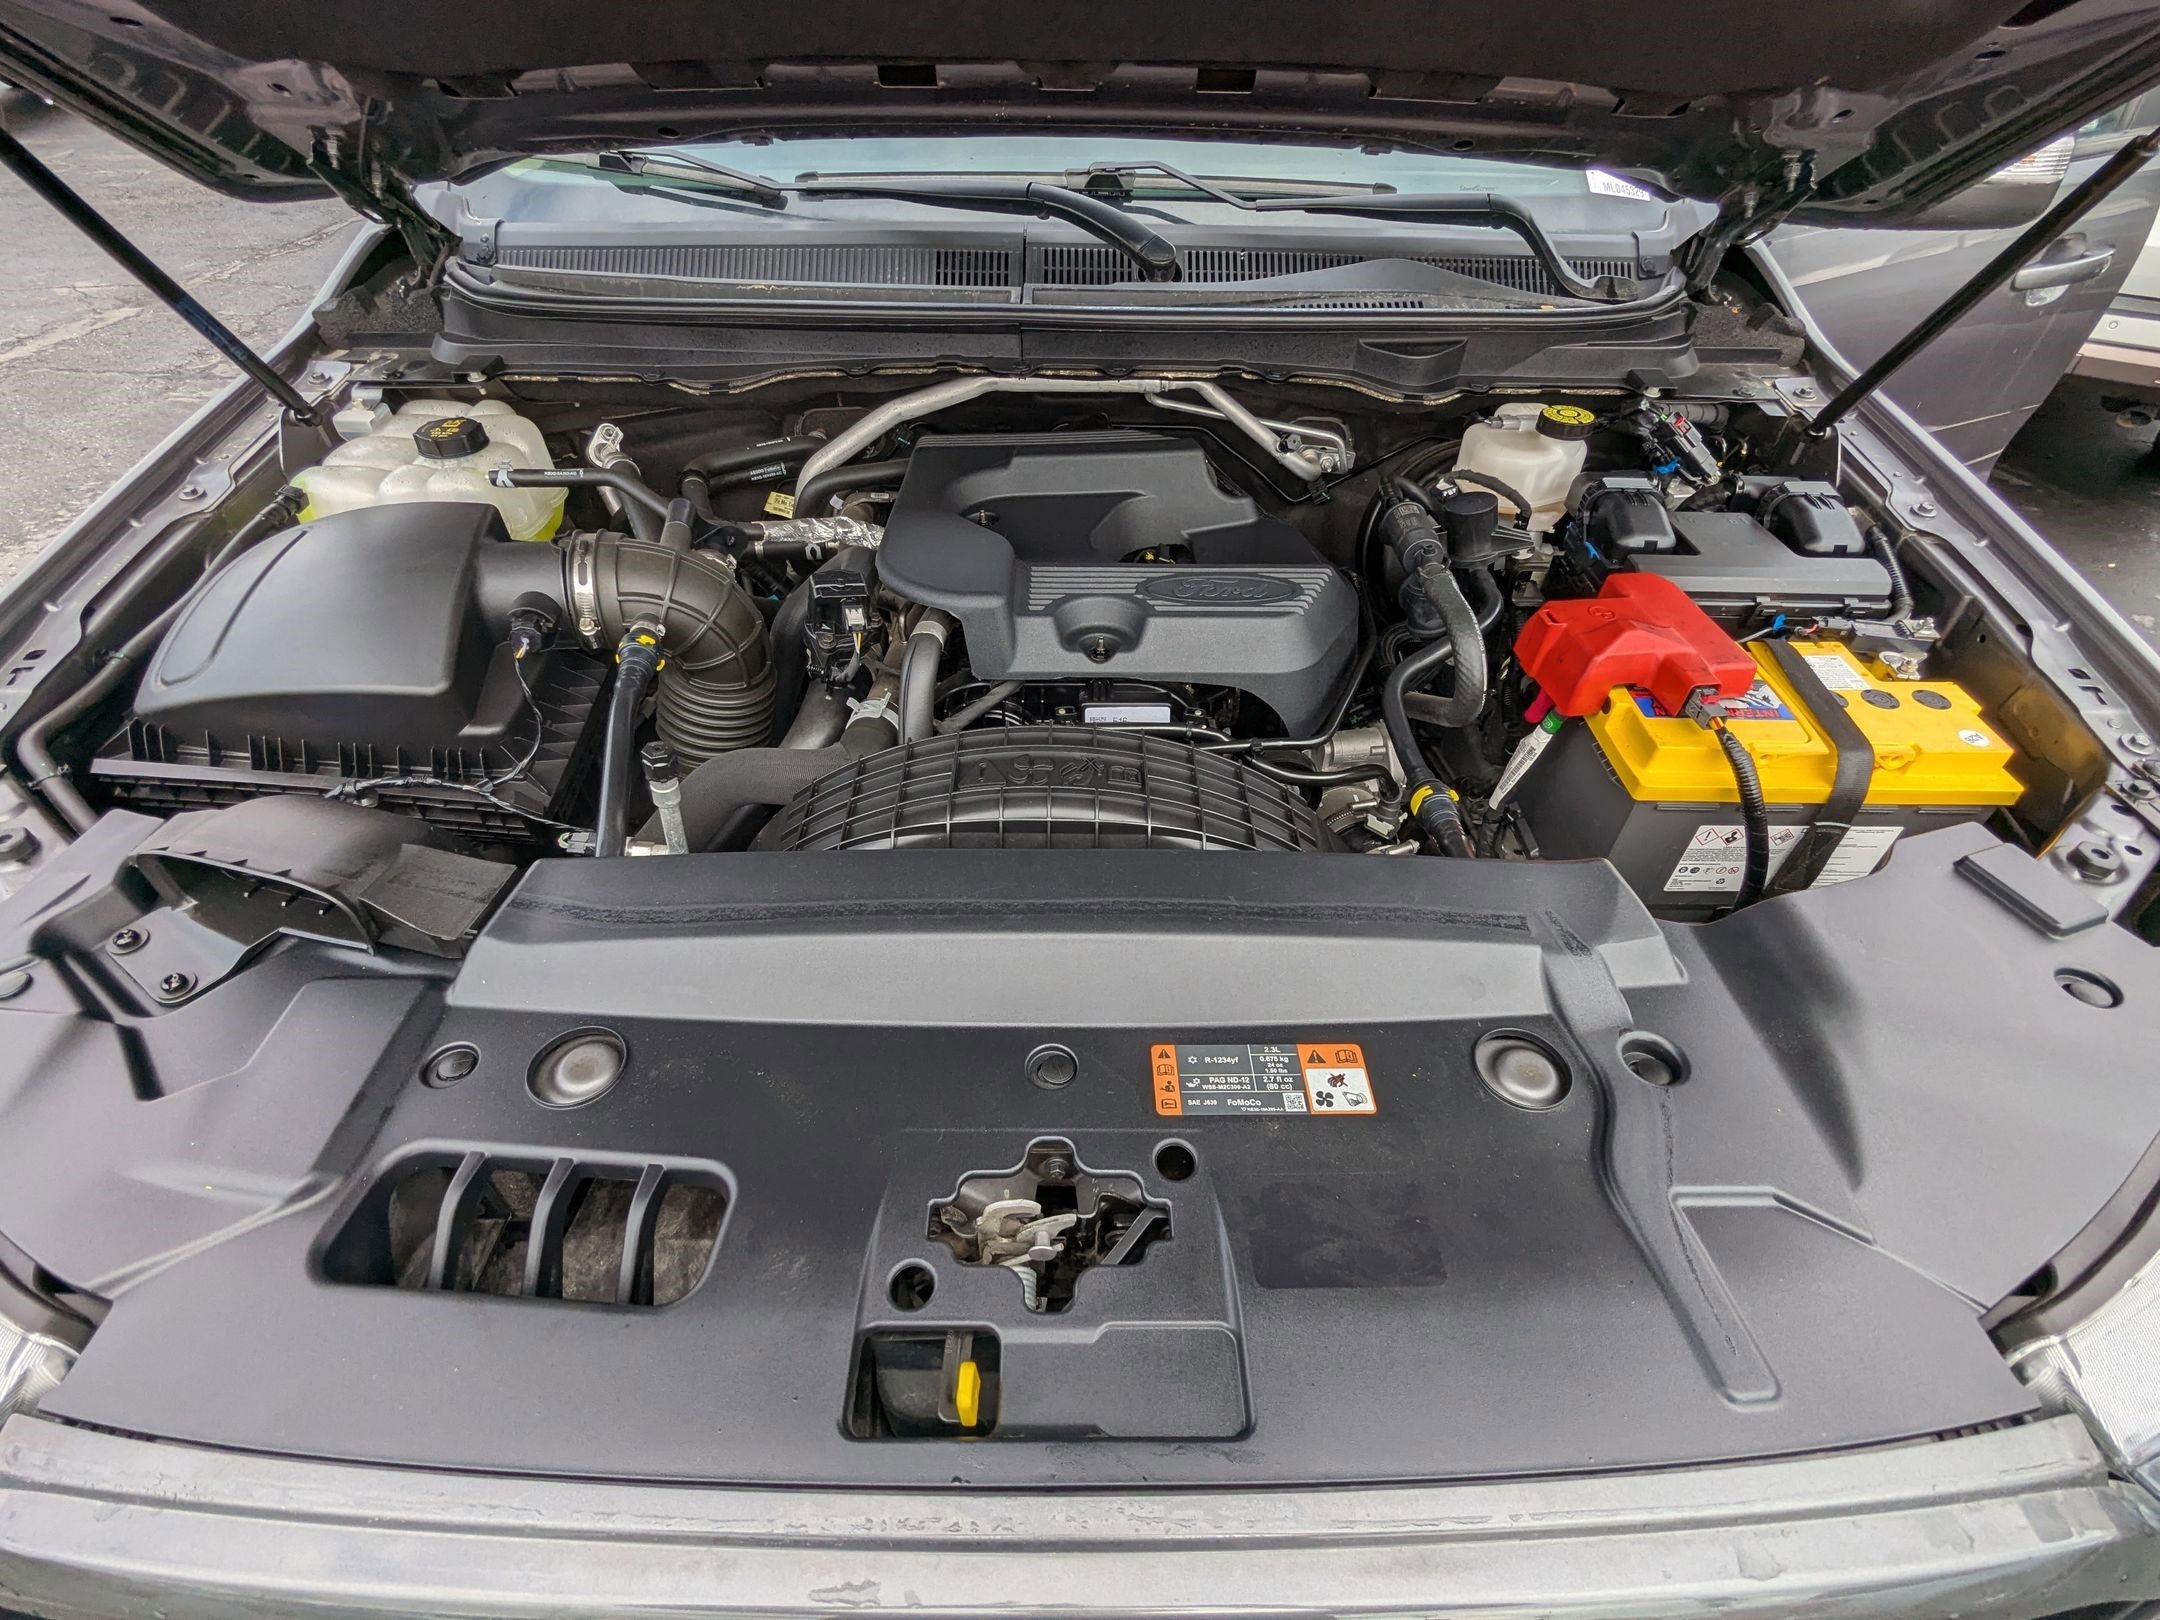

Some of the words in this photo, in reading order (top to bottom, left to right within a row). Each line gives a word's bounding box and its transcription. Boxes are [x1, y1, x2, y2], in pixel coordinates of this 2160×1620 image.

[1172, 578, 1269, 598] Ford
[1204, 1056, 1239, 1065] R-1234yf
[1266, 1083, 1280, 1091] (80
[1280, 1083, 1293, 1091] cc)
